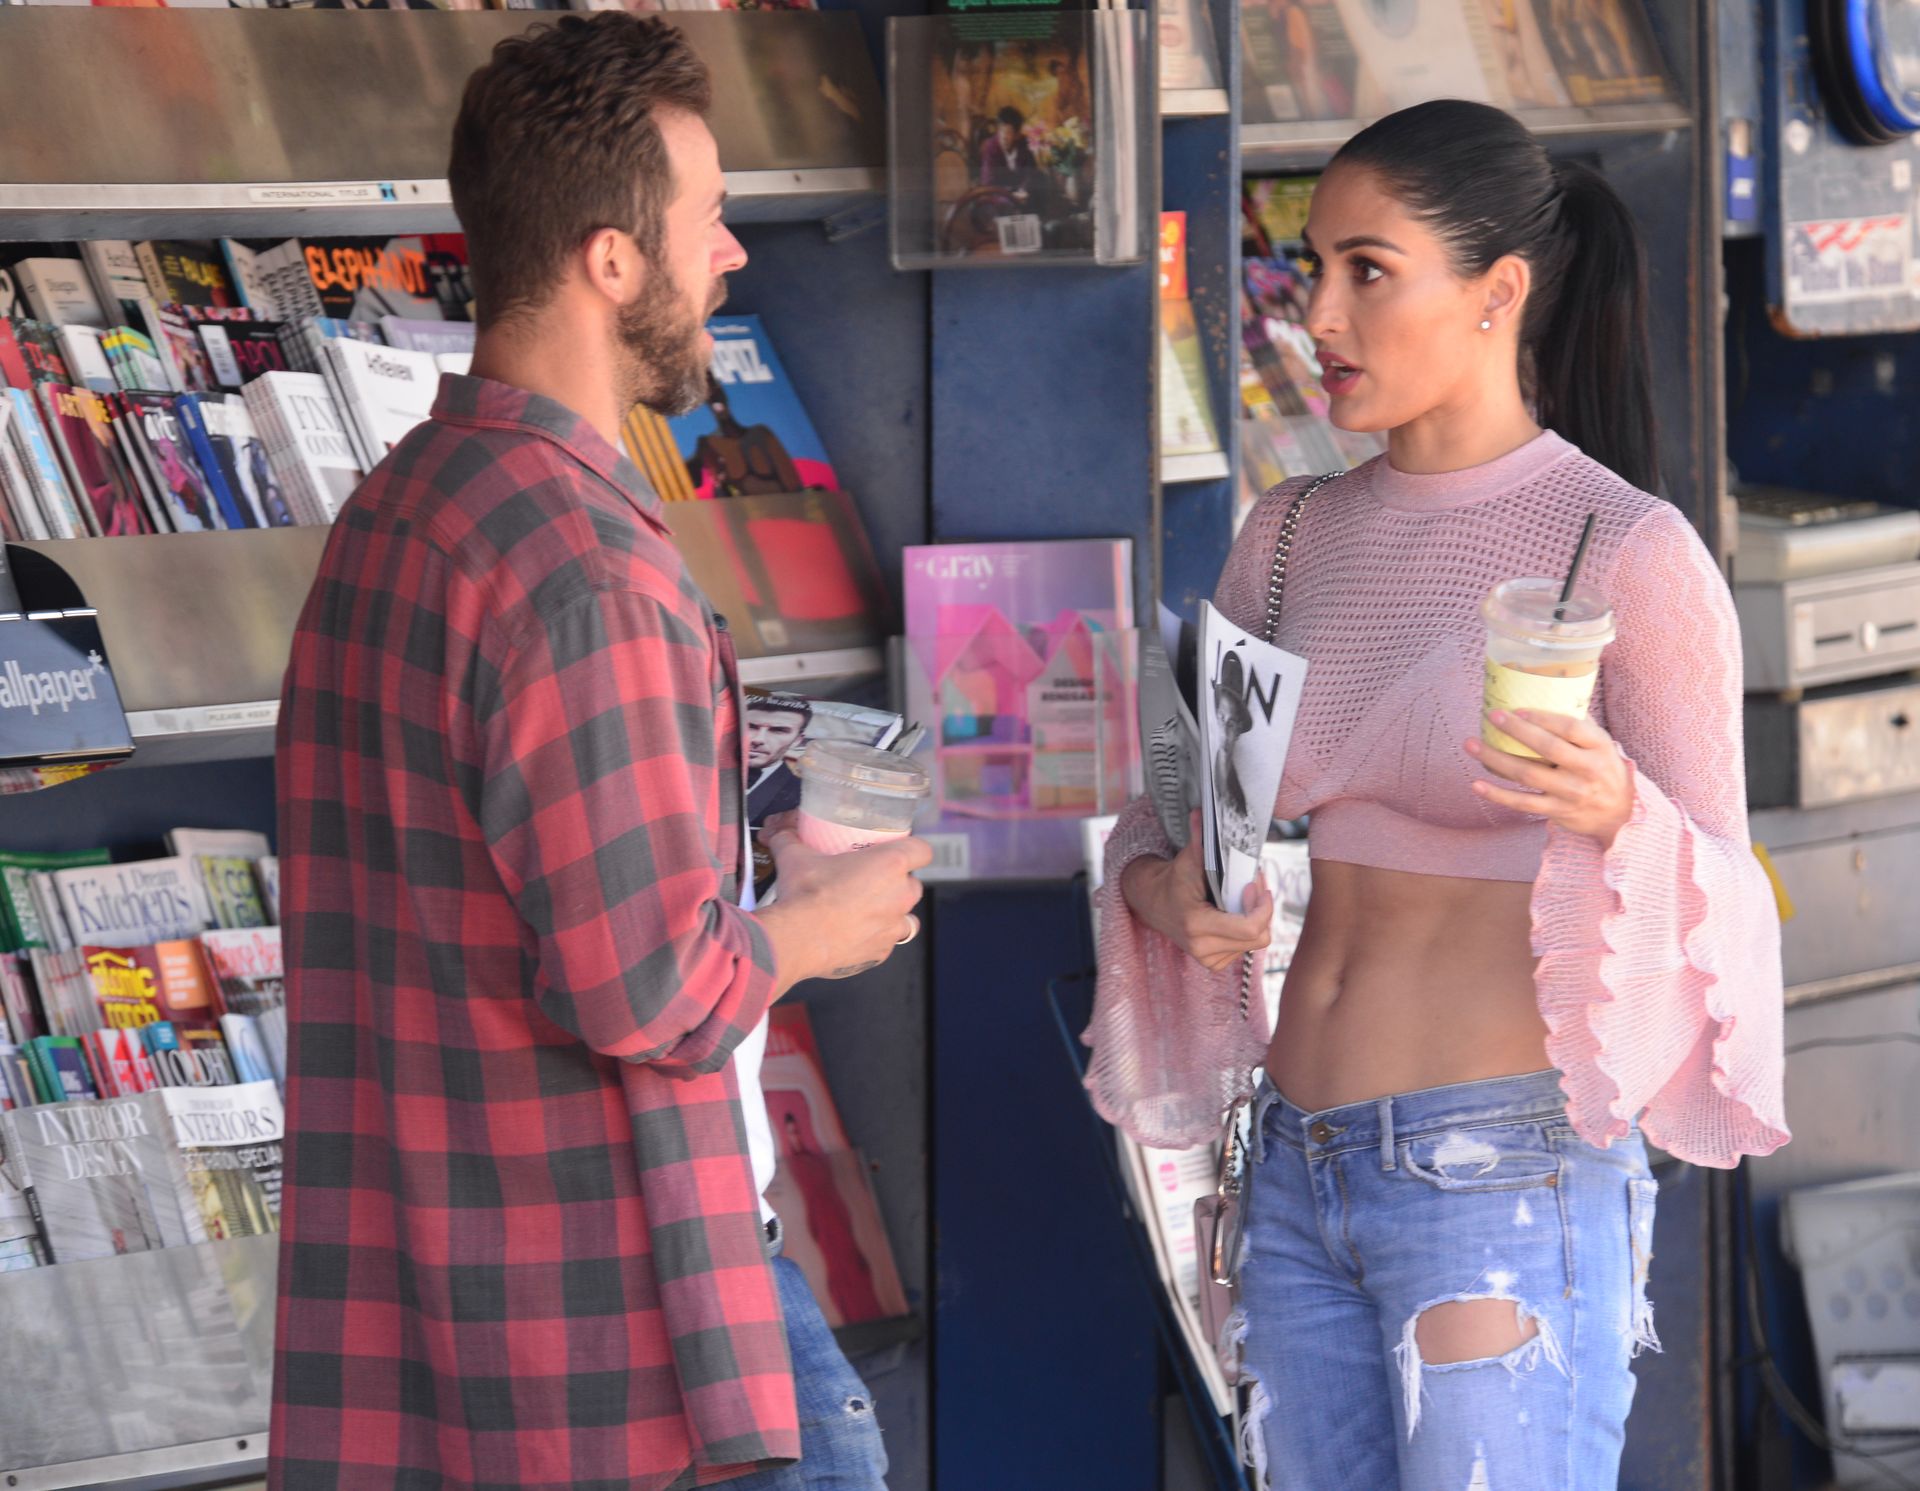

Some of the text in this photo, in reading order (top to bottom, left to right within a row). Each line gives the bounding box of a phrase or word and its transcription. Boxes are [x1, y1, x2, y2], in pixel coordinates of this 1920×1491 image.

[261, 188, 369, 199] INTERNATIONAL TITLES
[304, 245, 427, 294] ELEPHANT
[69, 872, 192, 932] Kitchens
[33, 1102, 149, 1147] INTERIOR
[61, 1140, 144, 1180] DESIGN
